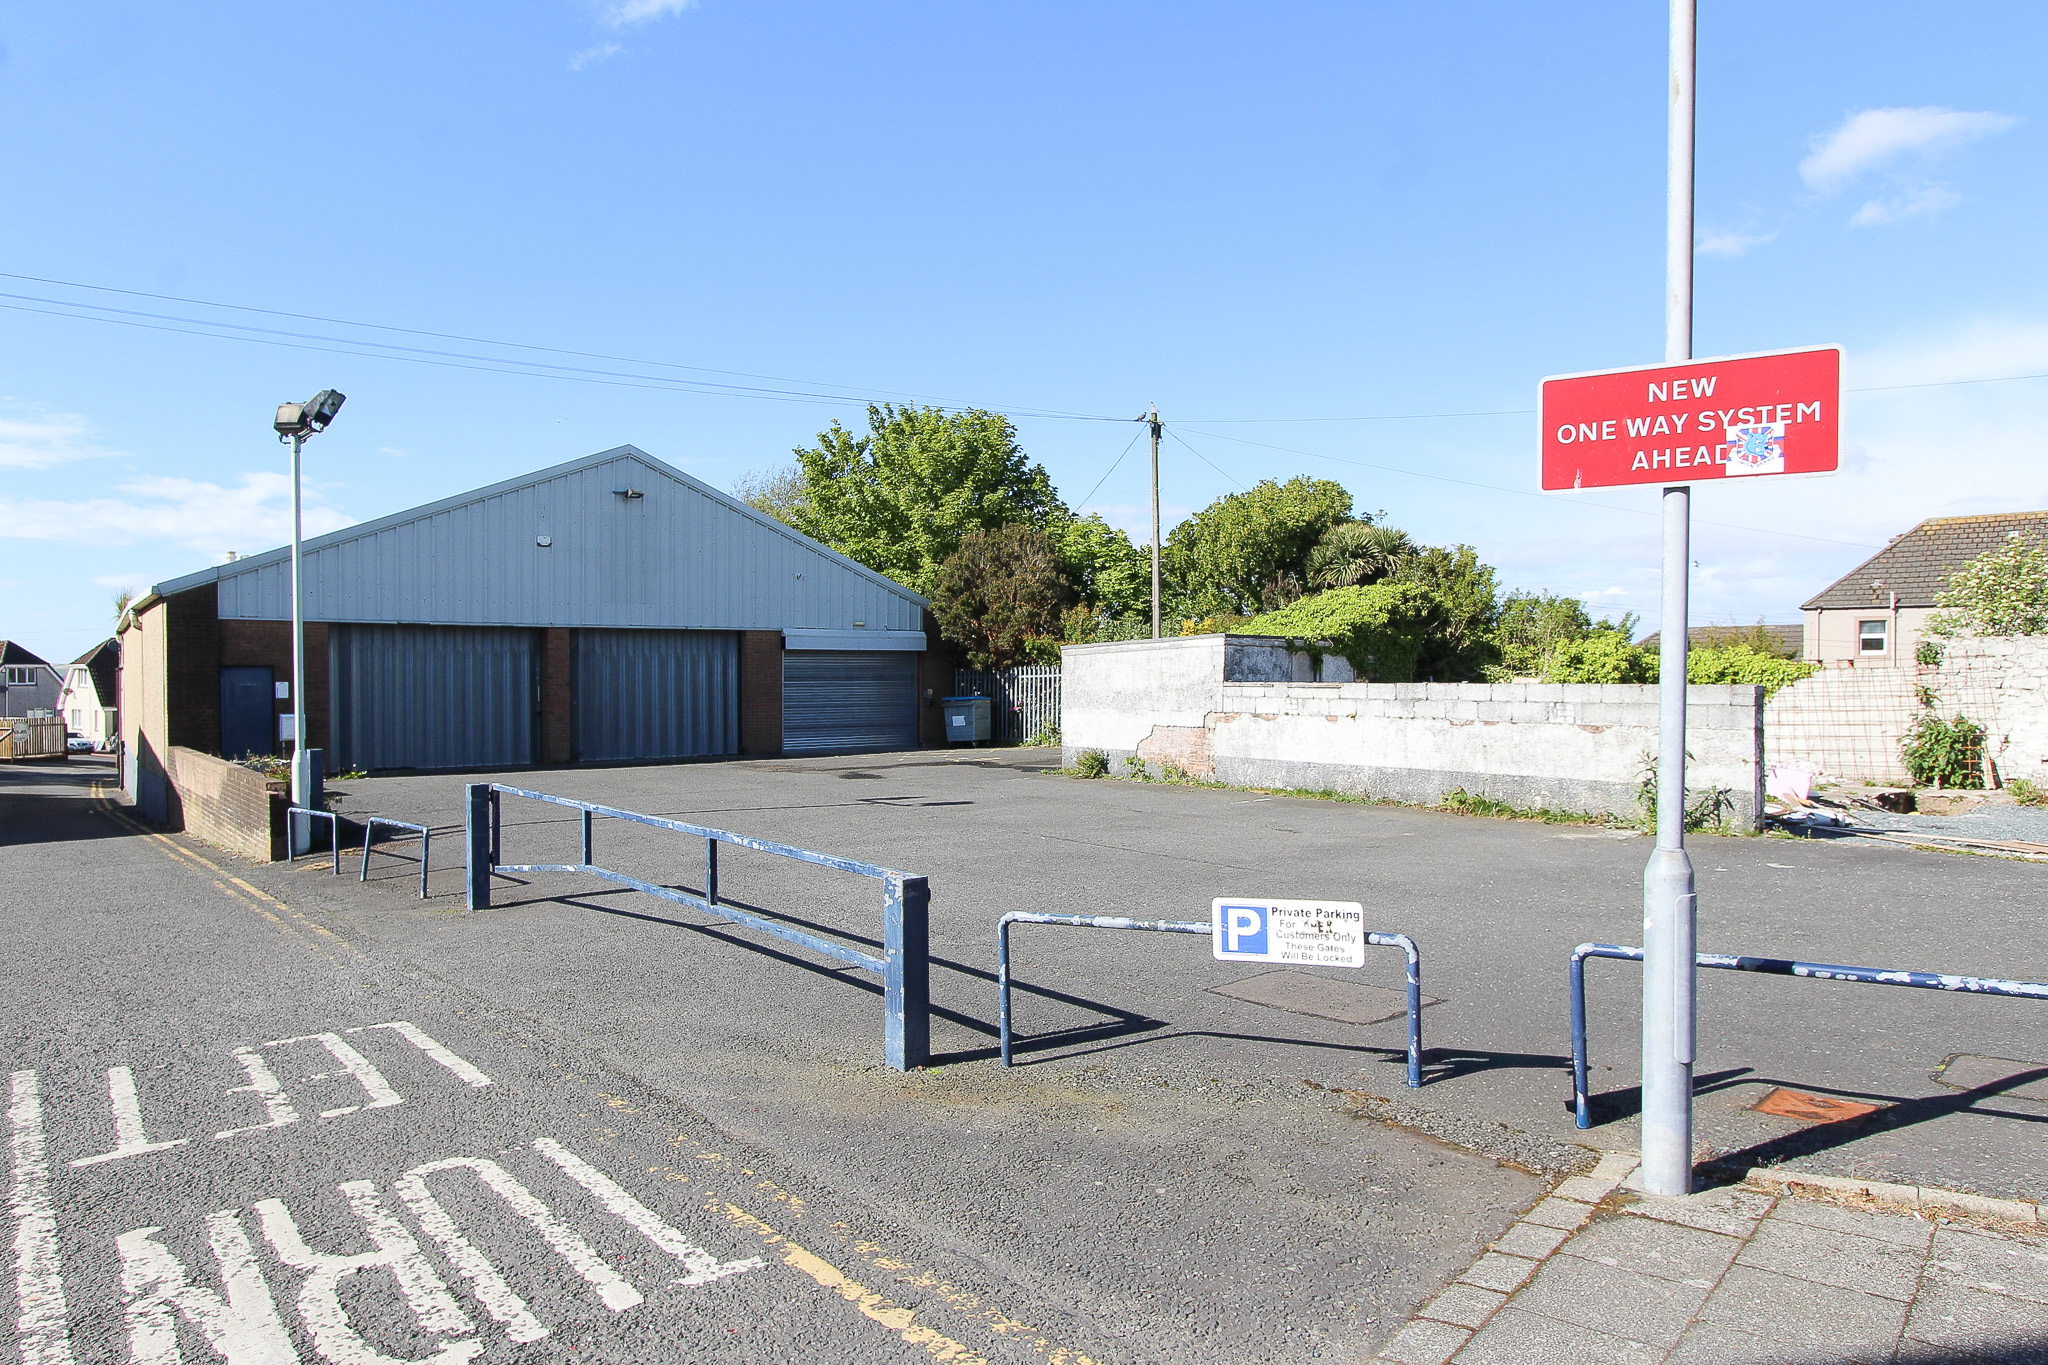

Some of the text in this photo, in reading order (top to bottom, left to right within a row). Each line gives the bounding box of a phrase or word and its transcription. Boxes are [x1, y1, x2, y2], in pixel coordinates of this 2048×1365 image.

[1647, 376, 1717, 403] NEW
[1557, 400, 1821, 444] ONE WAY SYSTEM
[1271, 907, 1360, 922] Private Parking
[1227, 908, 1261, 951] P
[1280, 919, 1296, 928] For
[1276, 930, 1356, 944] Customers Only
[1285, 942, 1345, 953] These Gates
[1281, 951, 1353, 963] Will Be Locked
[69, 1020, 495, 1167] LEFT
